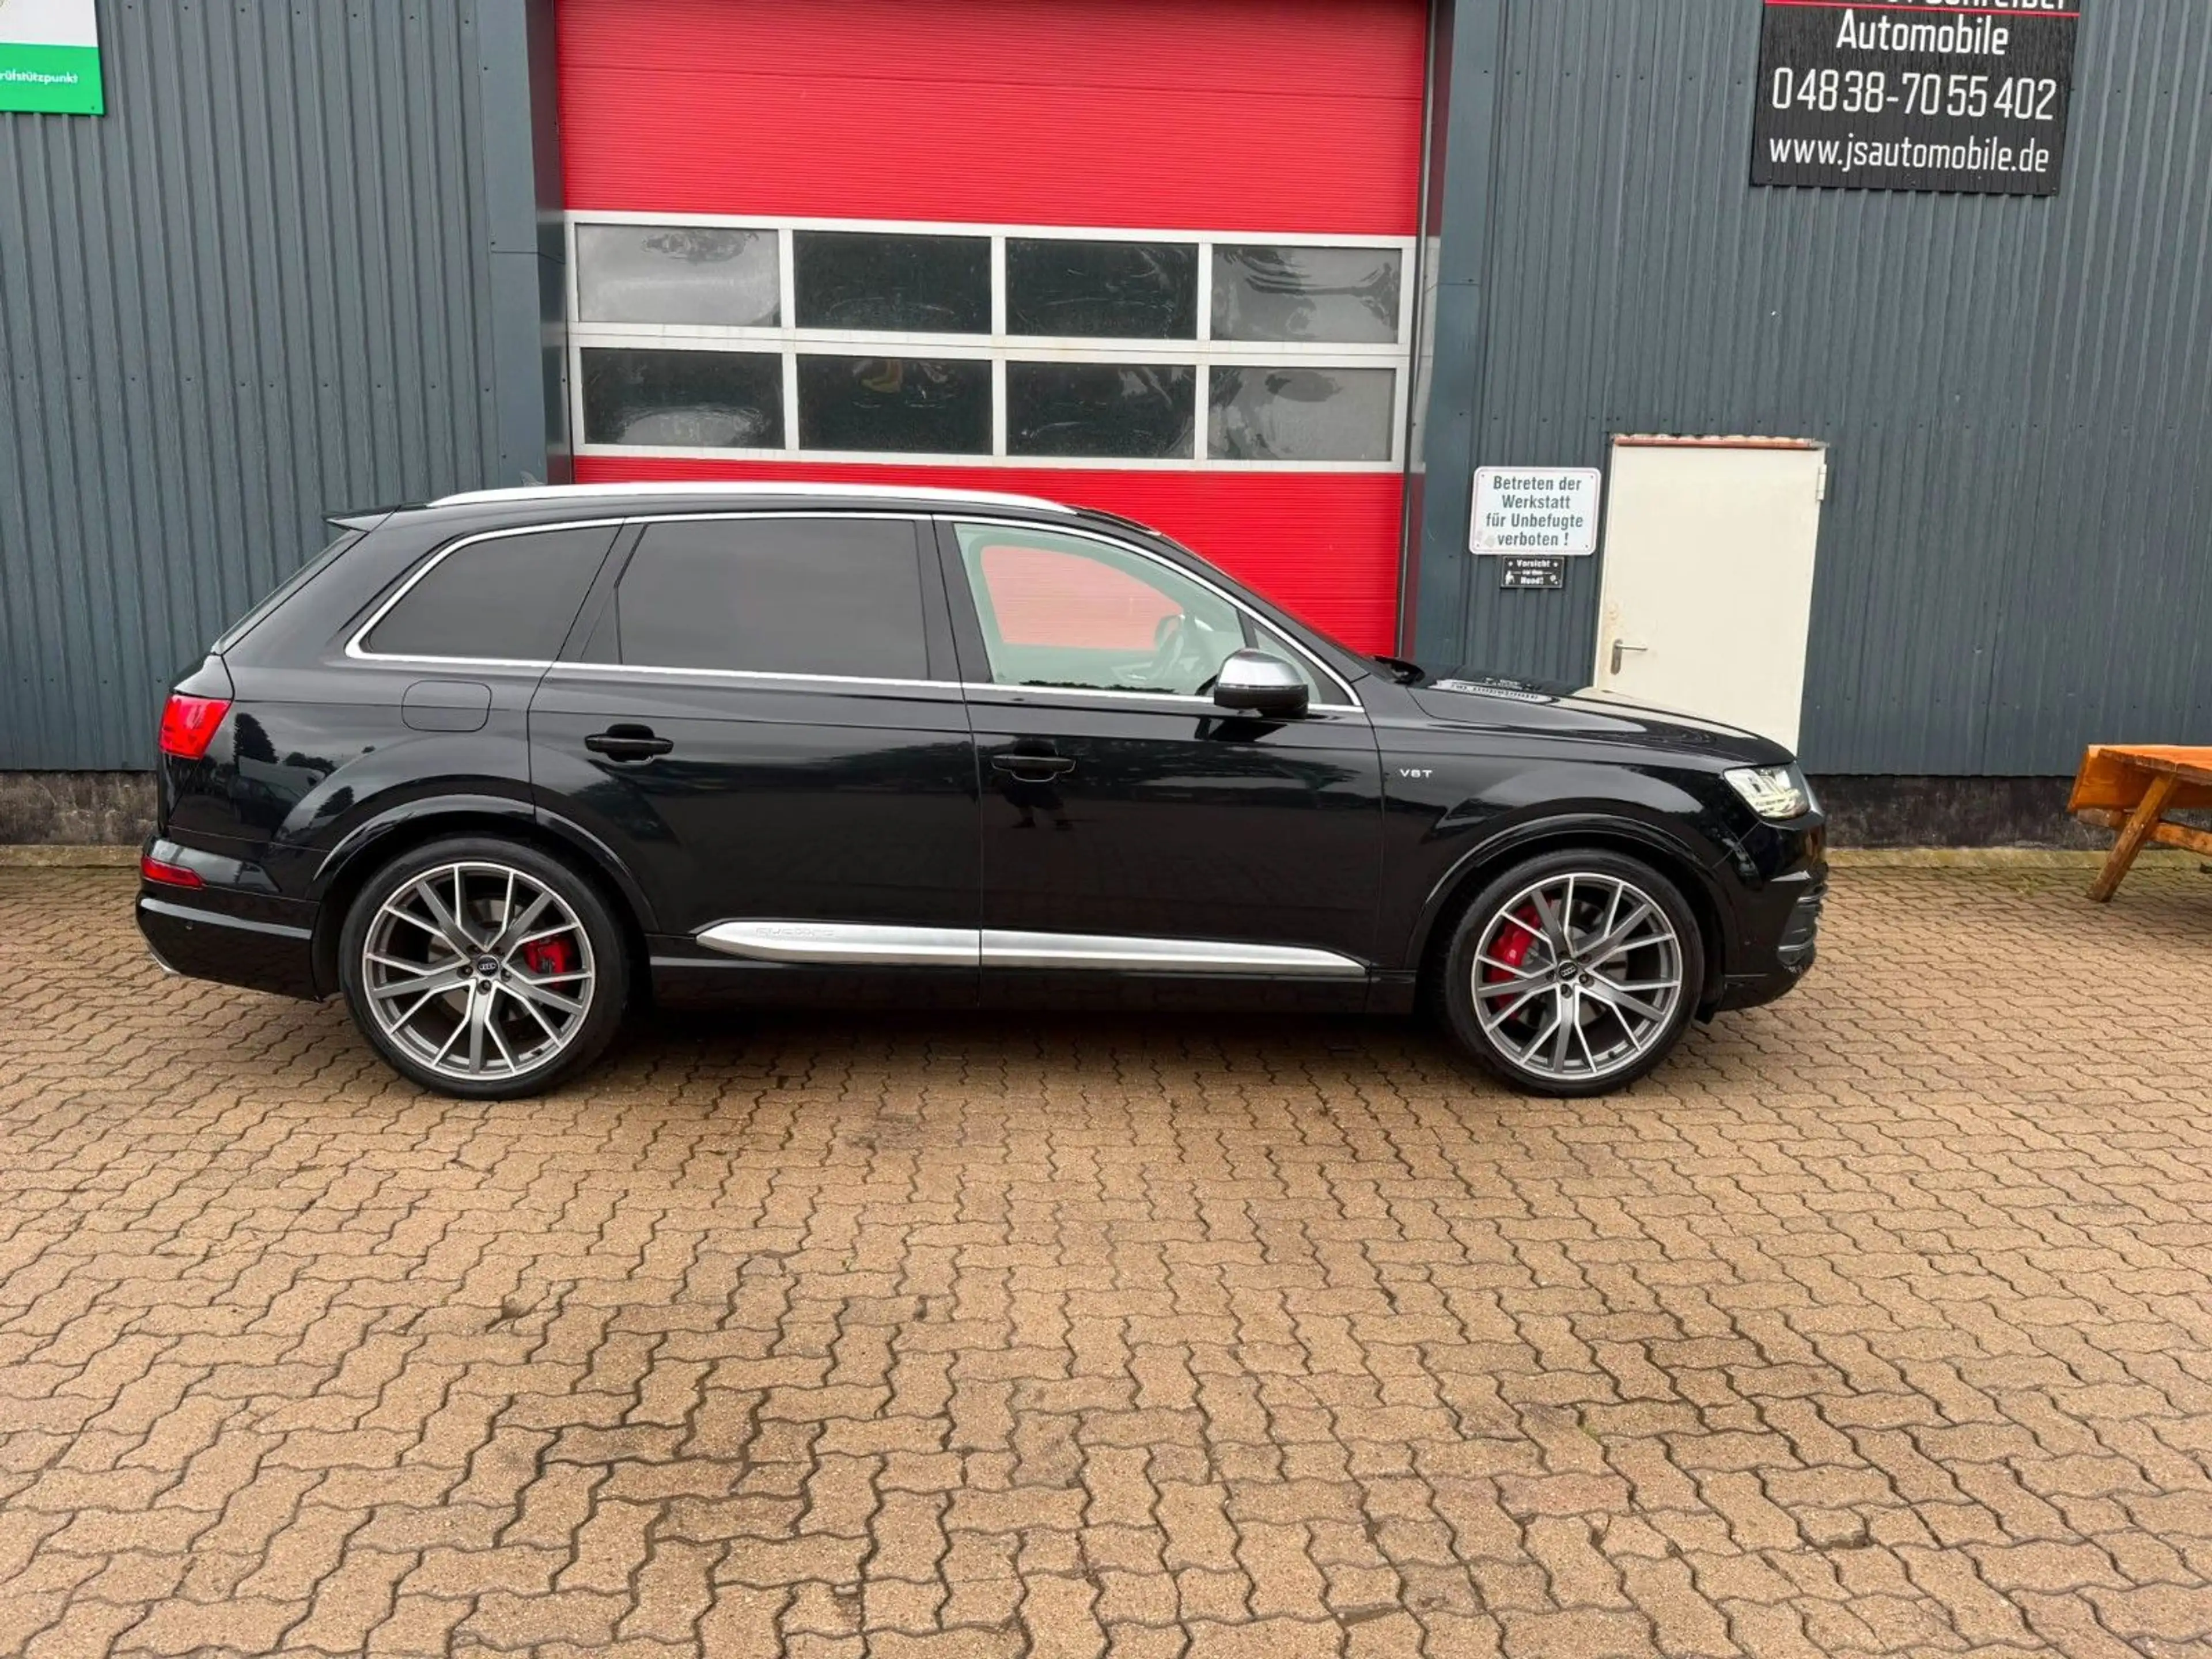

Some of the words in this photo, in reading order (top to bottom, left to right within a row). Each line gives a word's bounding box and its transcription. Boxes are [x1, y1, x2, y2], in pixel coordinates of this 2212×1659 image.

[1836, 9, 2009, 55] Automobile
[1770, 133, 2049, 172] www.jsautomobile.de
[1493, 475, 1554, 490] Betreten
[1559, 476, 1582, 491] der
[1501, 495, 1571, 509] Werkstatt
[1486, 513, 1506, 527] für
[1510, 513, 1584, 531] Unbefugte
[1497, 532, 1559, 546] verboten
